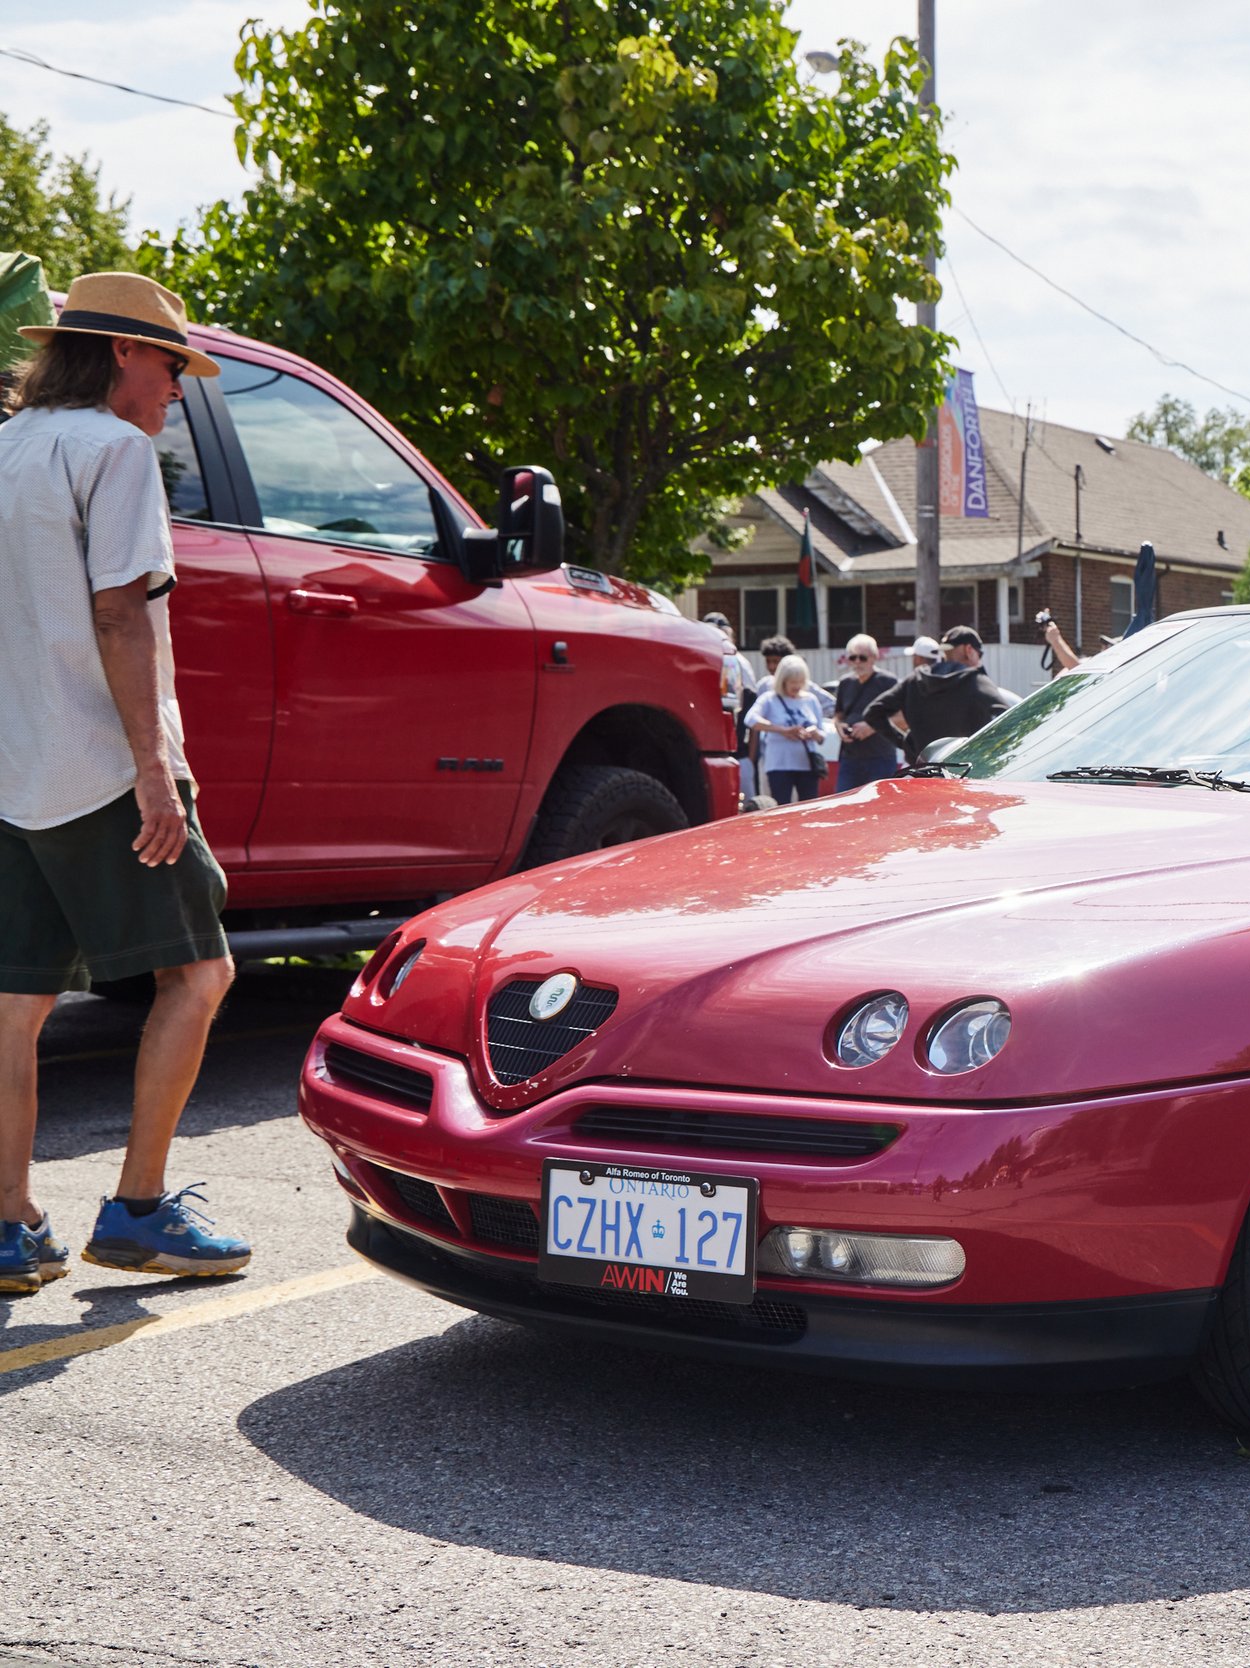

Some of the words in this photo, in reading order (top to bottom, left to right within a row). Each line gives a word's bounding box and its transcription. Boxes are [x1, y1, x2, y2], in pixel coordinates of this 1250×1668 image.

[961, 387, 986, 510] DANFORTH
[605, 1167, 621, 1176] Alfa
[622, 1168, 649, 1179] Romeo
[651, 1171, 660, 1180] of
[661, 1172, 691, 1183] Toronto
[553, 1195, 645, 1259] CZHX
[675, 1207, 743, 1268] 127
[600, 1264, 664, 1294] AWIN
[671, 1279, 687, 1288] Are
[673, 1271, 687, 1281] We
[670, 1286, 689, 1296] You.
